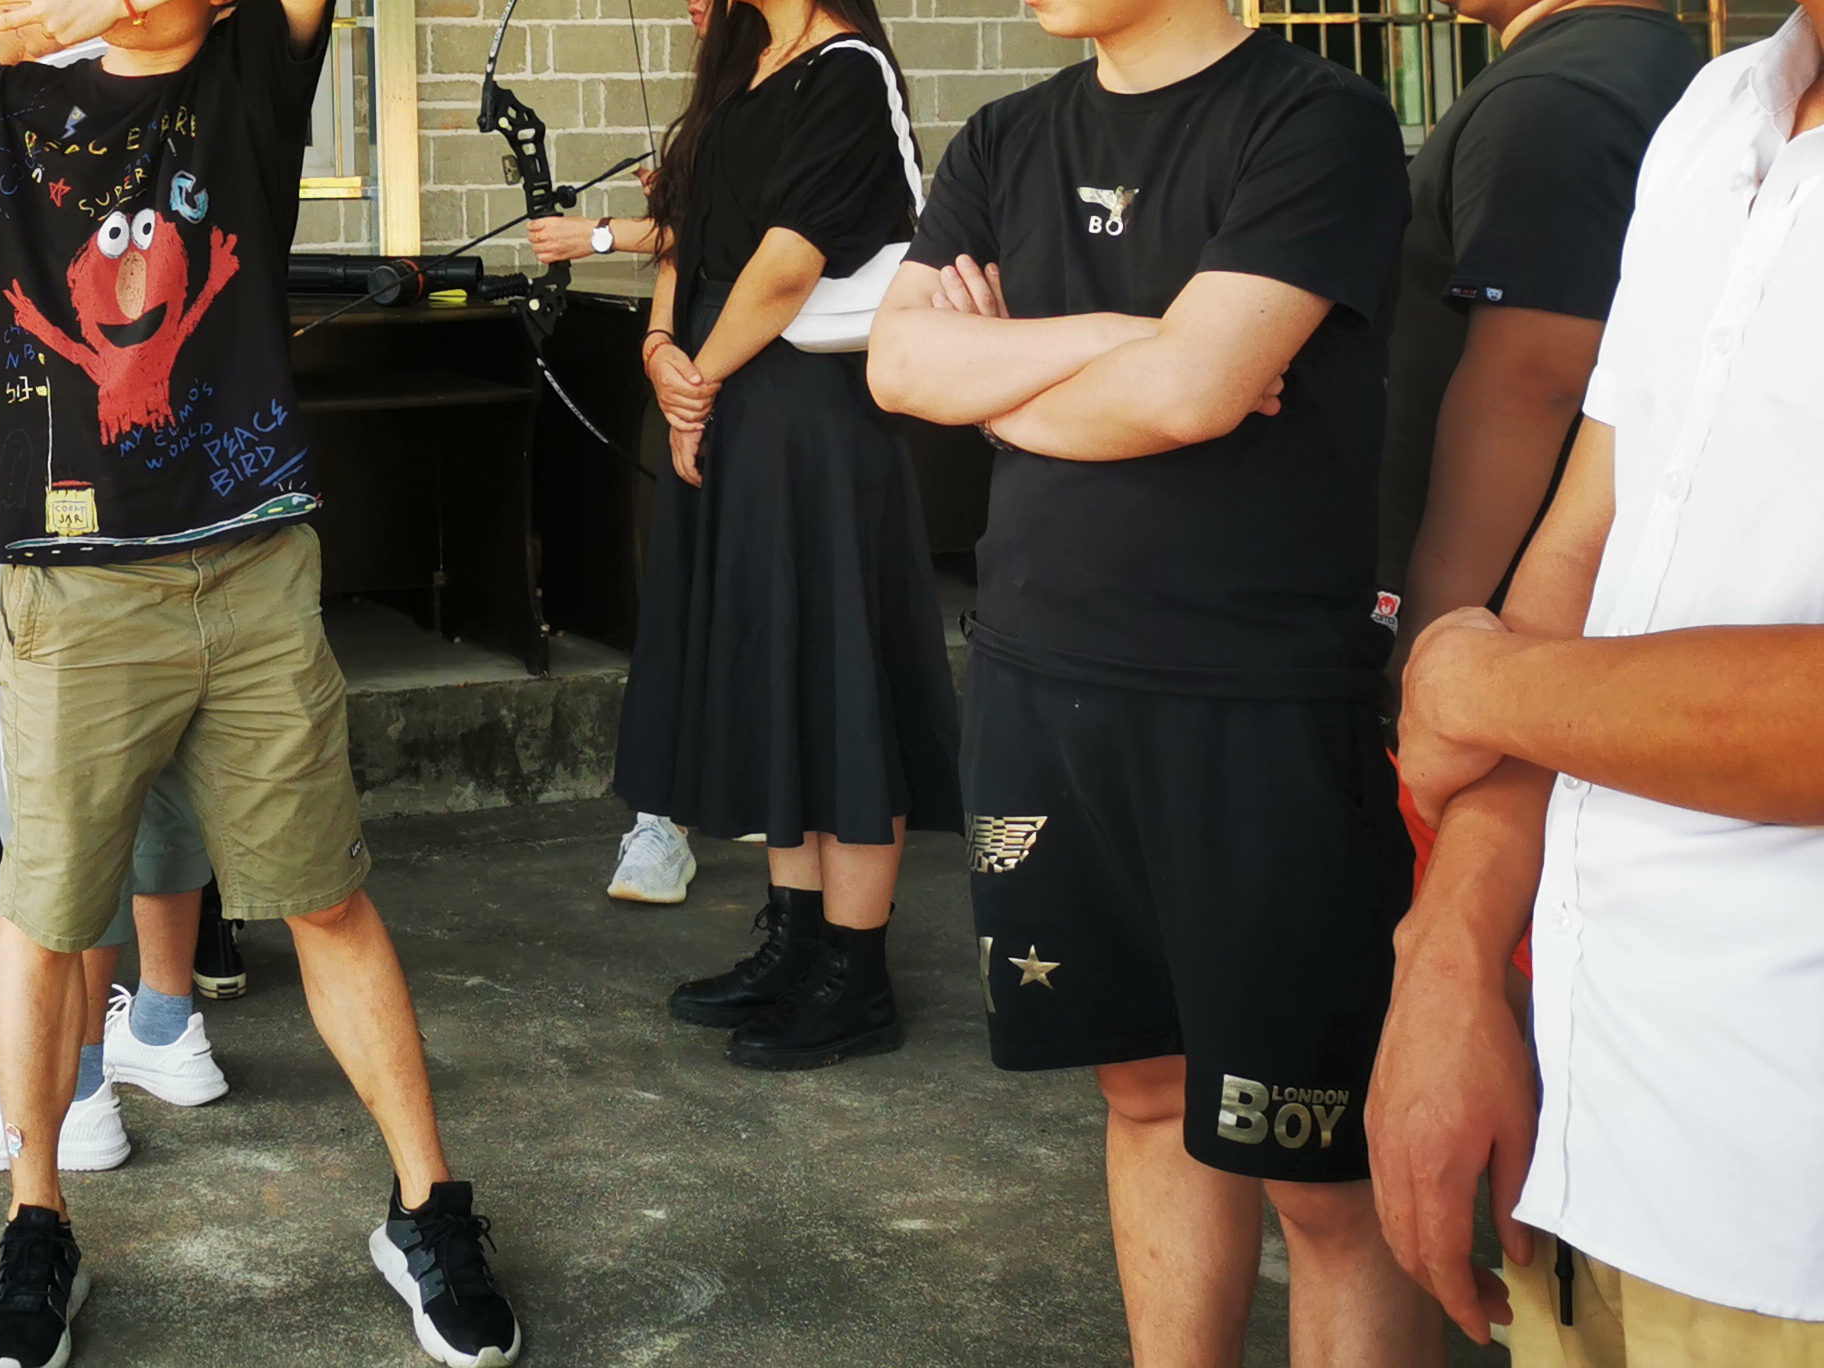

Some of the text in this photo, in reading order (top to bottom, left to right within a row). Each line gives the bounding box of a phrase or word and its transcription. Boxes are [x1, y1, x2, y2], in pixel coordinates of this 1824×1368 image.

[78, 167, 148, 218] SUPER
[209, 445, 276, 498] BIRD
[1217, 1074, 1346, 1149] BOY
[1271, 1085, 1350, 1106] LONDON
